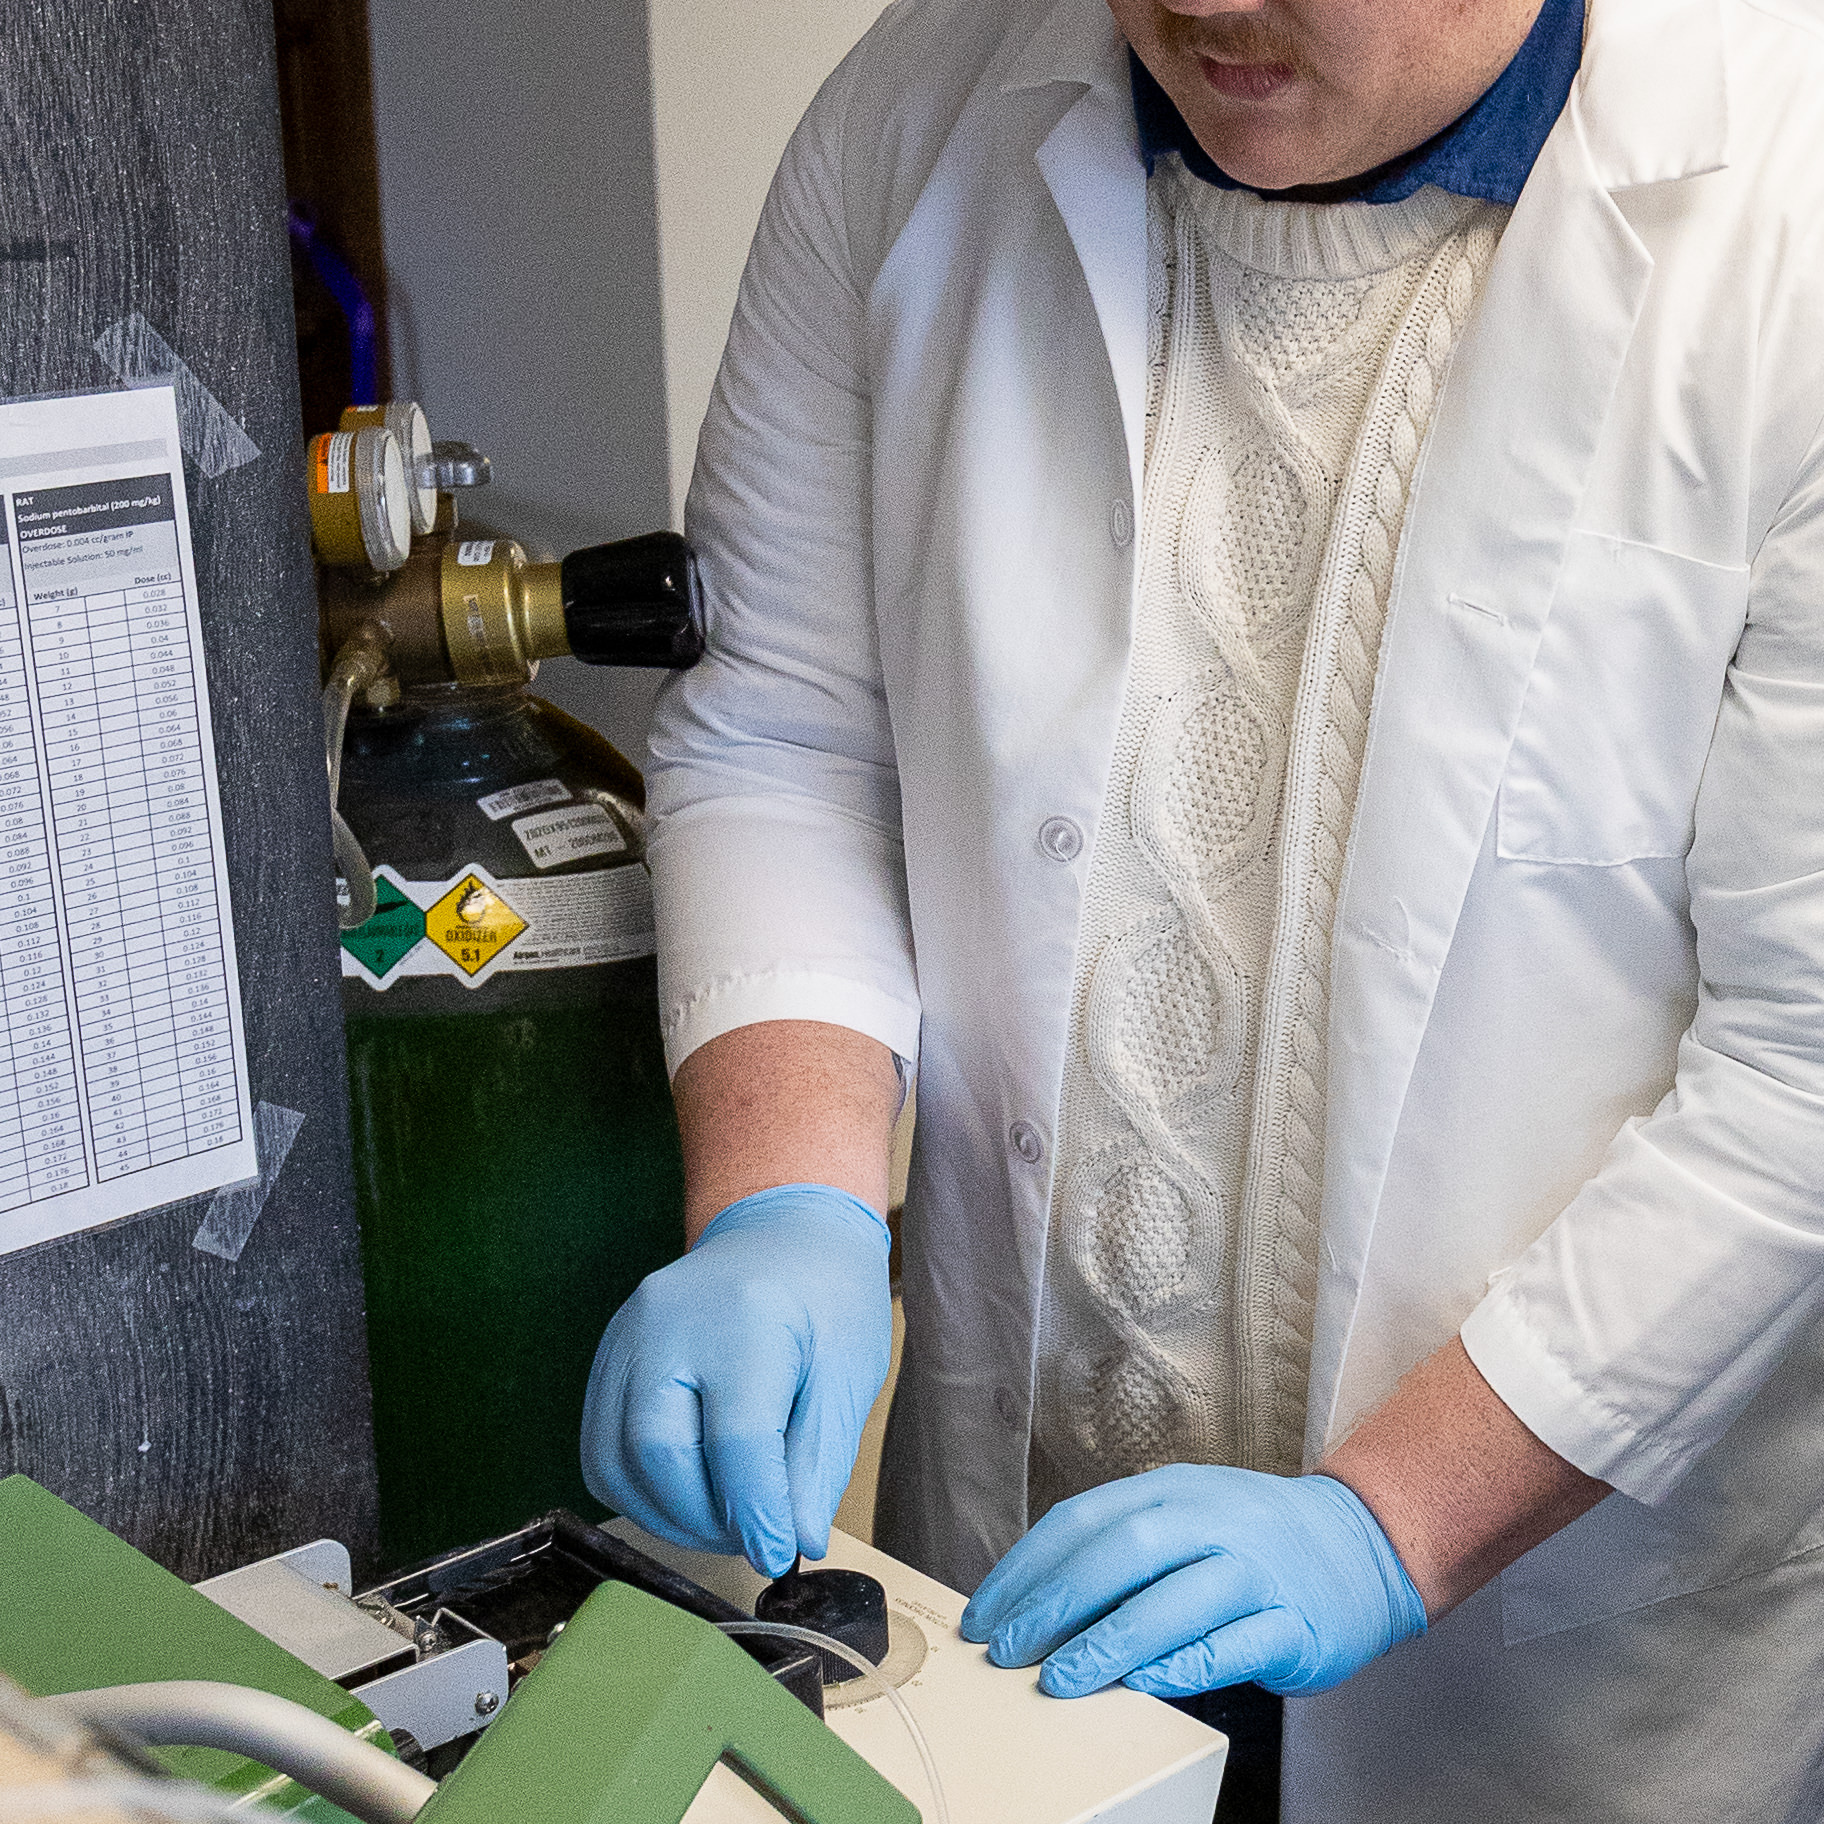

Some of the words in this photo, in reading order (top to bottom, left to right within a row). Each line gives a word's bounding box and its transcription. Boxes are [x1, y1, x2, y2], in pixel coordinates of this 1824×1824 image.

[16, 497, 34, 507] RAT
[18, 512, 51, 523] Sodium
[52, 502, 109, 520] pentobarbital
[110, 499, 130, 511] (200
[131, 495, 161, 509] mg/kg)
[20, 525, 68, 539] OVERDOSE
[22, 539, 65, 553] Overdose:
[66, 537, 90, 547] 0.004
[91, 532, 124, 545] cc/gram
[24, 558, 65, 571] Injectable
[67, 552, 103, 564] Solution:
[104, 549, 116, 558] 50
[117, 545, 143, 557] mg/ml
[33, 589, 65, 601] Weight
[66, 587, 78, 597] (g)
[134, 575, 155, 585] Dose
[156, 573, 172, 582] (cc)
[143, 588, 165, 598] 0.028
[145, 603, 167, 614] 0.032
[147, 619, 169, 629] 0.036
[58, 651, 69, 660] 10
[151, 634, 169, 644] 0.04
[60, 666, 70, 676] 11
[150, 649, 173, 659] 0.044
[61, 681, 72, 691] 12
[152, 664, 175, 674] 0.048
[64, 697, 74, 706] 13
[154, 679, 176, 689] 0.052
[65, 712, 76, 722] 14
[155, 693, 178, 704] 0.056
[67, 728, 78, 737] 15
[159, 709, 177, 719] 0.06
[69, 742, 80, 752] 16
[159, 723, 181, 734] 0.064
[71, 757, 81, 767] 17
[160, 737, 182, 749] 0.068
[73, 773, 83, 782] 18
[162, 752, 184, 764] 0.072
[74, 788, 85, 797] 19
[164, 767, 186, 778] 0.076
[76, 802, 86, 812] 20
[168, 782, 185, 792] 0.08
[0, 800, 24, 812] 0.076
[78, 818, 88, 827] 21
[167, 796, 189, 808] 0.084
[5, 816, 23, 827] 0.08
[79, 832, 90, 842] 22
[169, 811, 190, 822] 0.088
[5, 831, 28, 843] 0.084
[81, 847, 91, 857] 23
[170, 825, 191, 837] 0.092
[7, 846, 30, 858] 0.088
[83, 862, 93, 872] 24
[171, 840, 194, 851] 0.096
[9, 861, 31, 873] 0.092
[85, 877, 95, 886] 25
[178, 855, 190, 865] 0.1
[10, 876, 33, 888] 0.096
[87, 891, 97, 901] 26
[175, 868, 197, 880] 0.104
[17, 892, 30, 902] 0.1
[88, 906, 99, 916] 27
[176, 883, 198, 894] 0.108
[14, 906, 37, 918] 0.104
[90, 921, 100, 930] 28
[178, 897, 200, 909] 0.112
[16, 921, 39, 933] 0.108
[92, 935, 102, 945] 29
[180, 911, 202, 923] 0.116
[17, 935, 40, 948] 0.112
[94, 950, 104, 959] 30
[183, 926, 200, 937] 0.12
[445, 929, 497, 943] OXIDIZER
[19, 950, 43, 963] 0.116
[96, 965, 105, 974] 31
[183, 940, 205, 952] 0.124
[375, 949, 384, 963] 2
[461, 948, 480, 962] 5.1
[24, 965, 41, 977] 0.12
[97, 979, 107, 988] 32
[184, 954, 206, 966] 0.128
[23, 979, 46, 992] 0.124
[99, 993, 109, 1003] 33
[186, 969, 207, 980] 0.132
[25, 994, 48, 1007] 0.128
[101, 1008, 111, 1017] 34
[188, 983, 209, 994] 0.136
[27, 1008, 49, 1021] 0.132
[103, 1022, 113, 1031] 35
[191, 997, 208, 1008] 0.14
[29, 1023, 52, 1036] 0.136
[104, 1036, 114, 1046] 36
[191, 1010, 212, 1022] 0.144
[33, 1038, 51, 1050] 0.14
[106, 1050, 116, 1060] 37
[192, 1024, 214, 1036] 0.148
[32, 1052, 55, 1065] 0.144
[108, 1065, 117, 1074] 38
[194, 1038, 215, 1050] 0.152
[34, 1067, 57, 1079] 0.148
[109, 1079, 119, 1088] 39
[195, 1052, 217, 1064] 0.156
[36, 1081, 58, 1094] 0.152
[38, 1096, 61, 1108] 0.156
[110, 1093, 121, 1101] 40
[42, 1111, 60, 1122] 0.16
[112, 1107, 122, 1116] 41
[41, 1124, 64, 1137] 0.164
[114, 1121, 124, 1130] 42
[43, 1138, 65, 1151] 0.168
[115, 1135, 126, 1143] 43
[45, 1152, 66, 1165] 0.172
[117, 1149, 128, 1158] 44
[46, 1166, 69, 1179] 0.176
[119, 1163, 130, 1171] 45
[51, 1181, 68, 1192] 0.18
